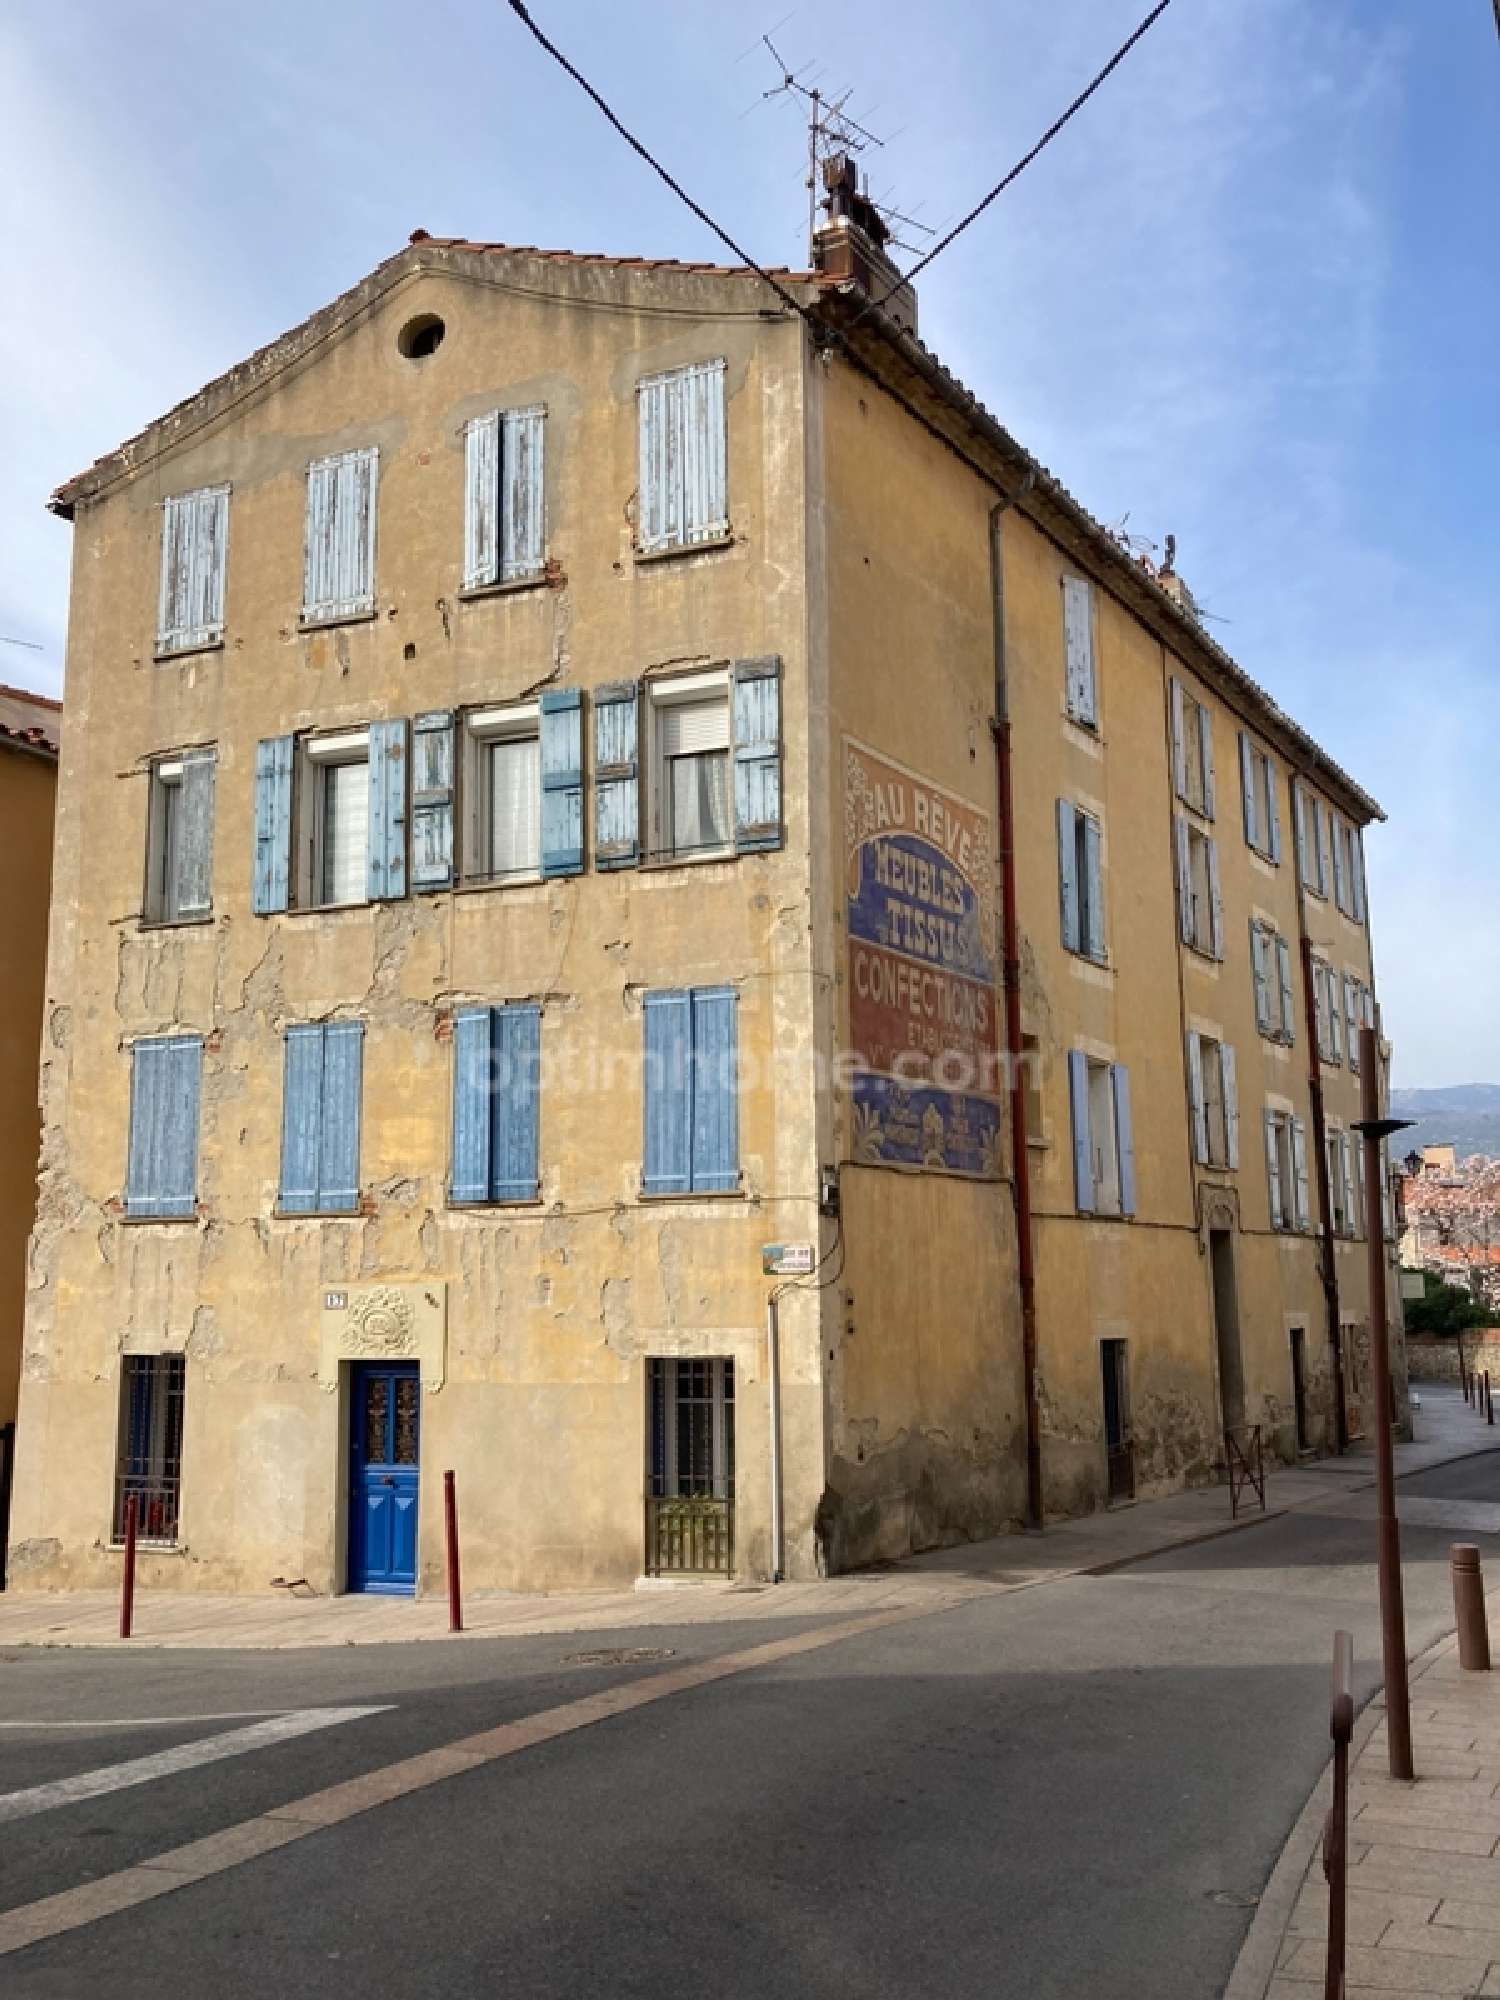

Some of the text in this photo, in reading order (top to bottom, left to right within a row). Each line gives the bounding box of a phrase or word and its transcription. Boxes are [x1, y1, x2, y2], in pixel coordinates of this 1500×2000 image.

[874, 783, 905, 829] AU
[874, 839, 964, 915] MEUBLES
[855, 951, 989, 1033] CONFECTIONS
